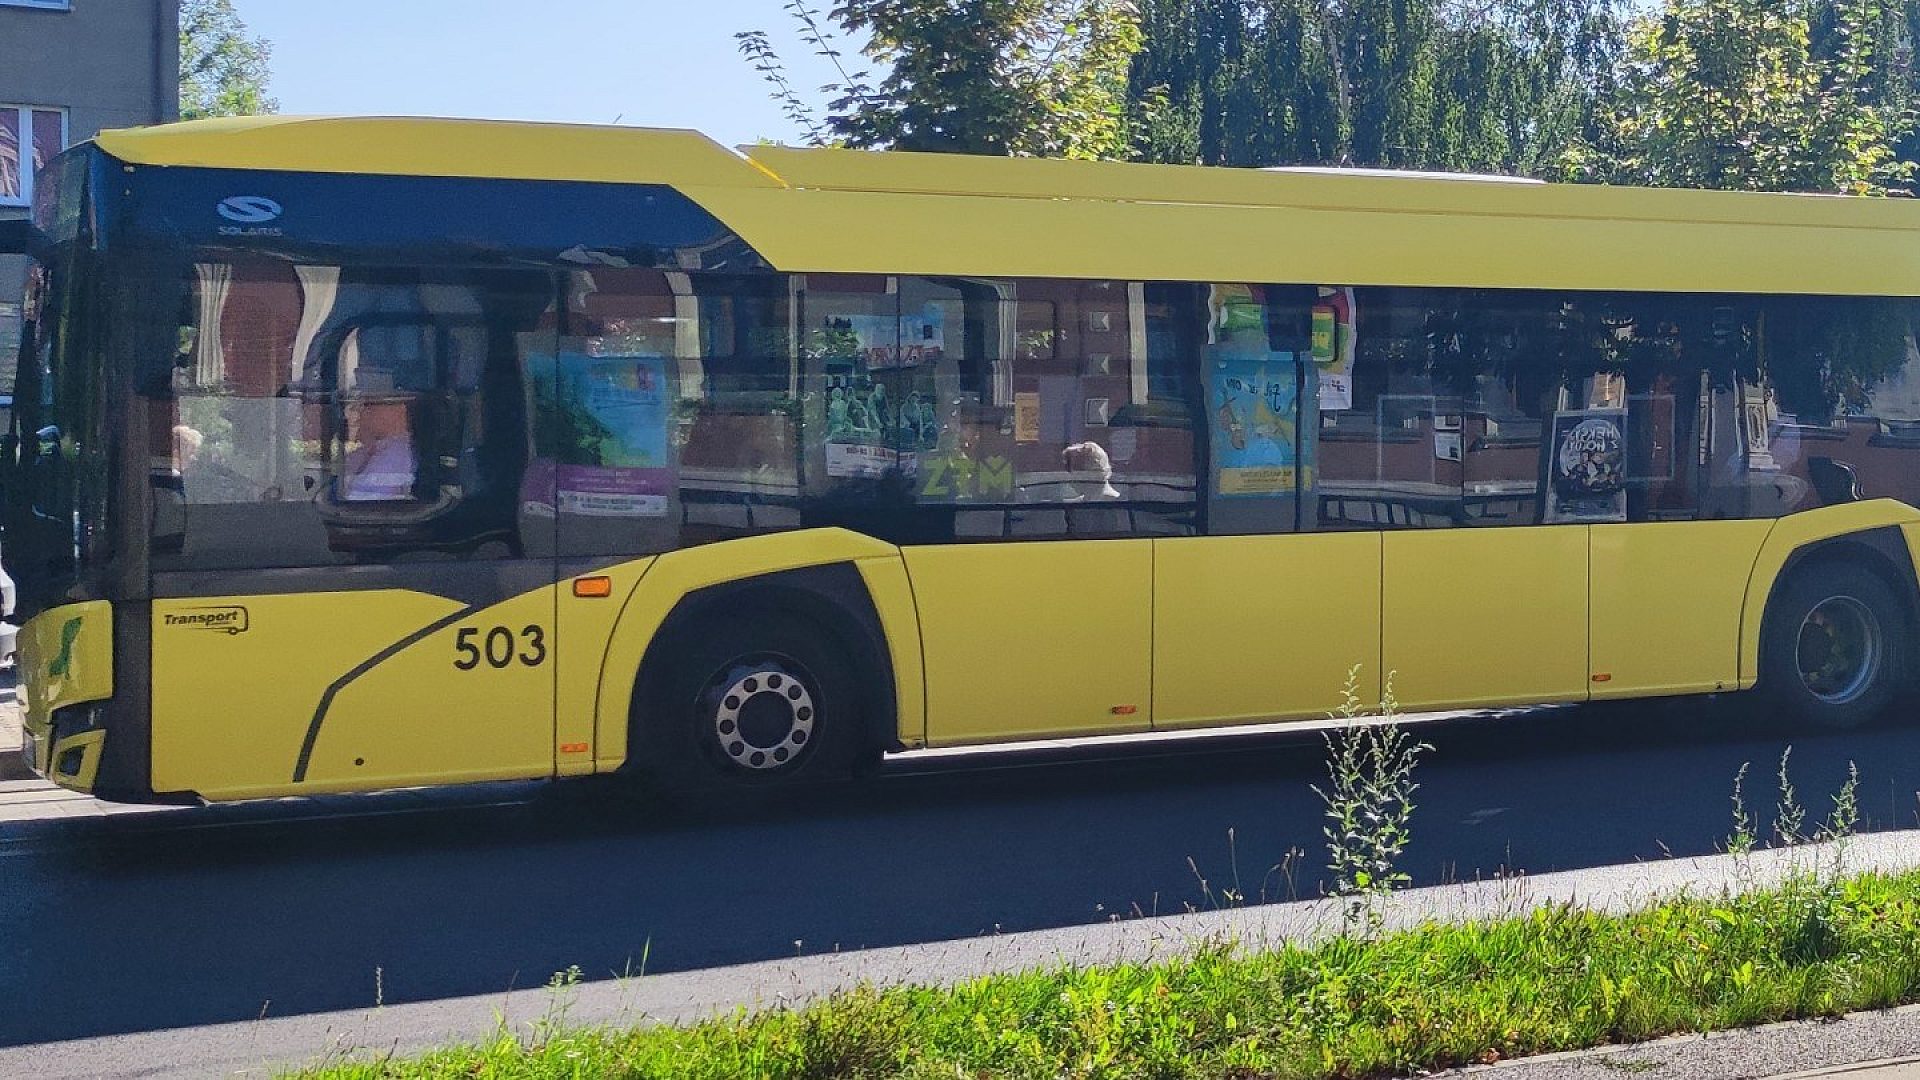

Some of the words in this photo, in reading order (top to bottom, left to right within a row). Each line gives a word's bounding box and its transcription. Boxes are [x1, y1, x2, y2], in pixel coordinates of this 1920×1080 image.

[217, 226, 283, 237] SOLARIS
[921, 456, 1013, 496] ZTM
[164, 611, 238, 626] Transport
[453, 624, 546, 670] 503
